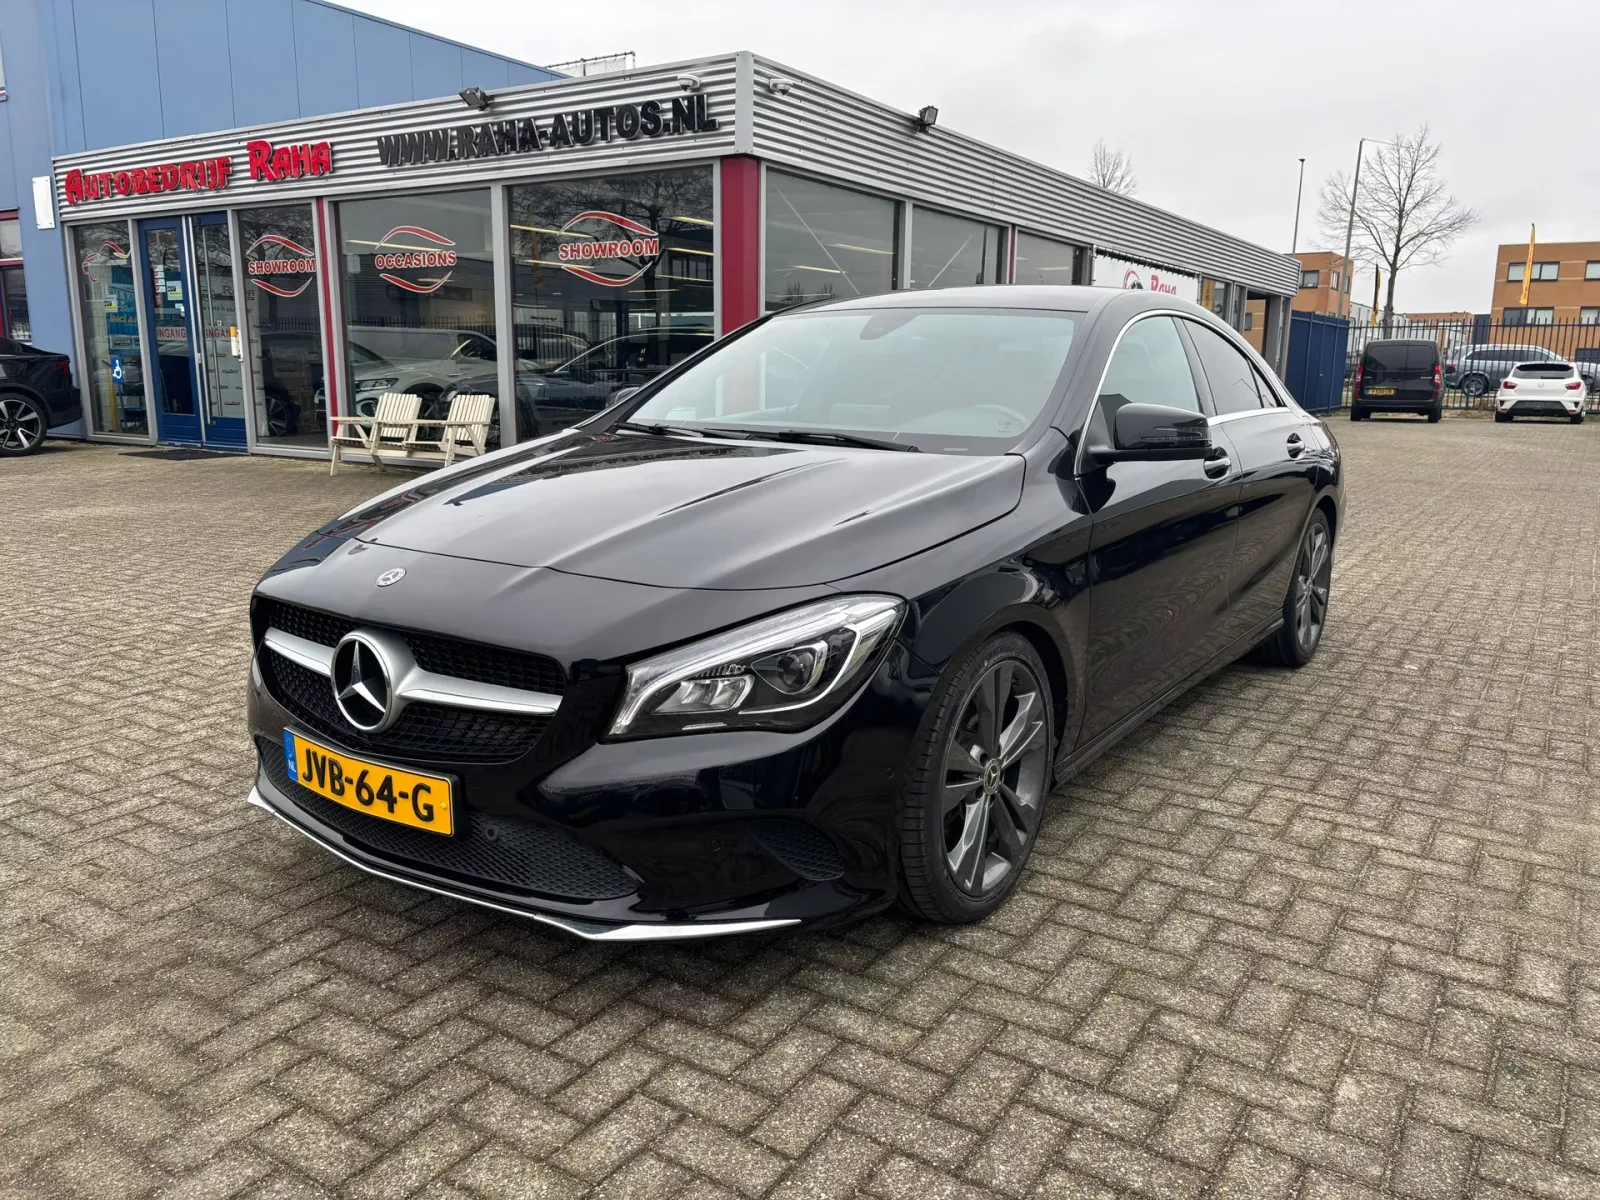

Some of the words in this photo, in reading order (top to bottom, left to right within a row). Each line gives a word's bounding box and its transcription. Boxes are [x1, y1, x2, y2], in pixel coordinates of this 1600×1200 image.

[377, 94, 719, 167] WWW.RAHA-AUTOS.NL
[246, 139, 333, 182] RAHA
[375, 250, 457, 270] OCCASIONS
[558, 238, 659, 261] SHOWROOM
[248, 258, 316, 276] SHOWROOM
[206, 328, 232, 339] INGAN
[287, 758, 297, 773] NL
[302, 747, 435, 823] JVB-64-G
